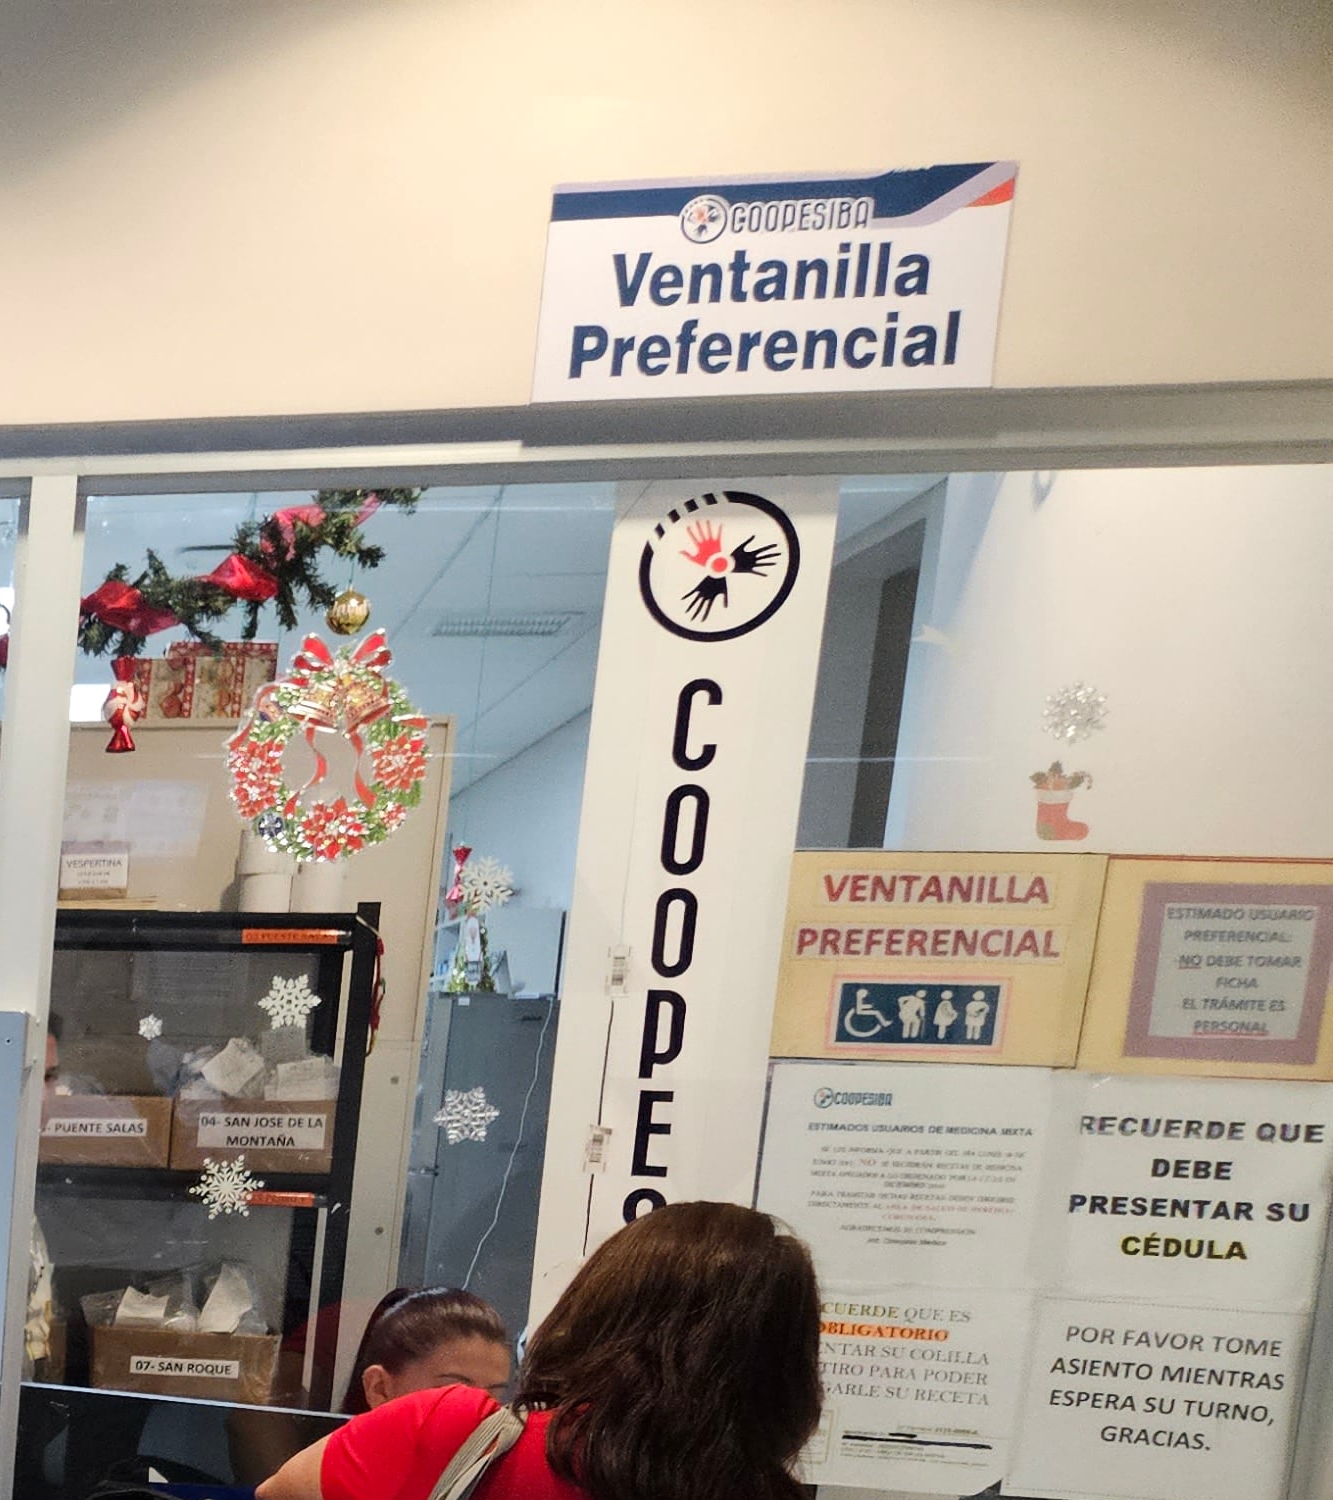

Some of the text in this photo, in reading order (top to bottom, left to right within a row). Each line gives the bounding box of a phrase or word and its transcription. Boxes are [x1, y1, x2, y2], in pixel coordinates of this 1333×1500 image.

[730, 198, 872, 234] COOPESIBA
[612, 241, 931, 308] Ventanilla
[568, 310, 961, 380] Preferencial
[66, 858, 121, 868] VESPERTINA
[824, 875, 1049, 904] VENTANILLA
[1167, 908, 1314, 921] ESTIMADO USUARIO
[796, 928, 1060, 958] PREFERENCIAL
[1179, 955, 1302, 968] NO DEBE TOMAR
[1216, 978, 1258, 988] FICHA
[1182, 999, 1196, 1010] EL
[1268, 1000, 1285, 1011] ES
[1194, 1021, 1268, 1032] PERSONAL
[55, 1123, 102, 1133] PUENTE
[106, 1123, 144, 1133] SALAS
[224, 1116, 250, 1127] SAN
[253, 1116, 283, 1128] JOSE
[288, 1117, 304, 1128] DE
[307, 1118, 323, 1128] LA
[1081, 1116, 1325, 1143] RECUERDE QUE
[226, 1134, 295, 1147] MONTAÑA
[1151, 1158, 1233, 1180] DEBE
[1069, 1195, 1310, 1222] PRESENTAR SU
[1121, 1233, 1247, 1260] CÉDULA
[822, 1302, 971, 1322] CUERDE QUE ES
[1066, 1326, 1282, 1357] POR FAVOR TOME
[881, 1347, 906, 1359] SU
[909, 1348, 989, 1365] COLILLA
[135, 1360, 232, 1375] 07- SAN ROQUE
[869, 1364, 988, 1385] PARA PODER
[1050, 1357, 1284, 1391] ASIENTO MIENTRAS
[885, 1385, 909, 1399] SU
[915, 1389, 990, 1406] RECETA
[1049, 1389, 1275, 1426] ESPERA SU TURNO,
[1100, 1425, 1211, 1451] GRACIAS.
